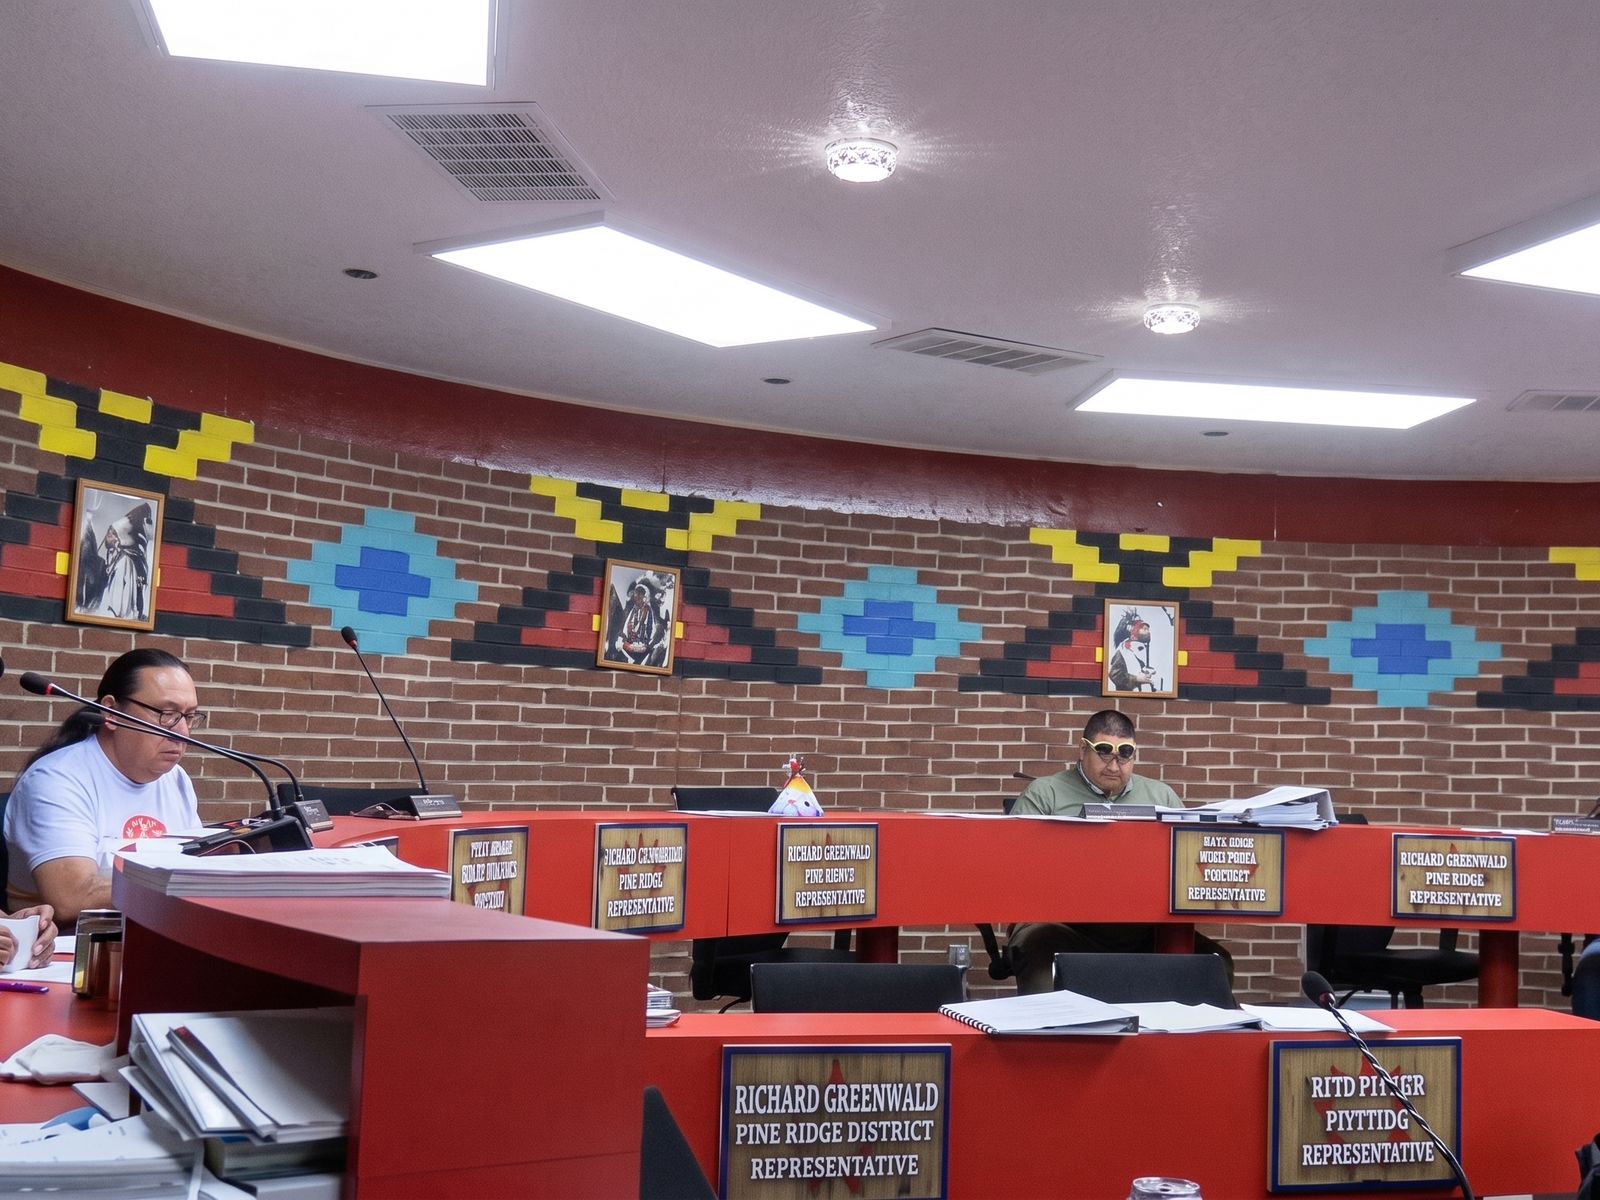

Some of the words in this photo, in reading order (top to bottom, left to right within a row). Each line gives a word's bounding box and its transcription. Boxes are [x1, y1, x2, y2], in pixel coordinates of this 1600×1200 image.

[788, 845, 822, 862] RICHARD
[824, 844, 871, 860] GREENWALD
[1400, 852, 1444, 867] RICHARD
[1446, 853, 1507, 868] GREENWALD
[619, 873, 637, 890] PINE
[1425, 872, 1451, 885] PINE
[1452, 873, 1484, 886] RIDGE
[795, 889, 865, 907] REPRESENTATIVE
[1188, 887, 1266, 901] REPRESENTATIVE
[1409, 890, 1502, 906] REPRESENTATIVE
[607, 896, 675, 917] REPRESENTATIVE
[1311, 1076, 1356, 1098] RITD
[735, 1084, 820, 1114] RICHARD
[824, 1082, 939, 1113] GREENWALD
[735, 1123, 781, 1145] PINE
[785, 1121, 843, 1144] RIDGE
[847, 1119, 934, 1143] DISTRICT
[1302, 1141, 1435, 1166] REPRESENTATIVE
[750, 1154, 919, 1179] REPRESENTATIVE
